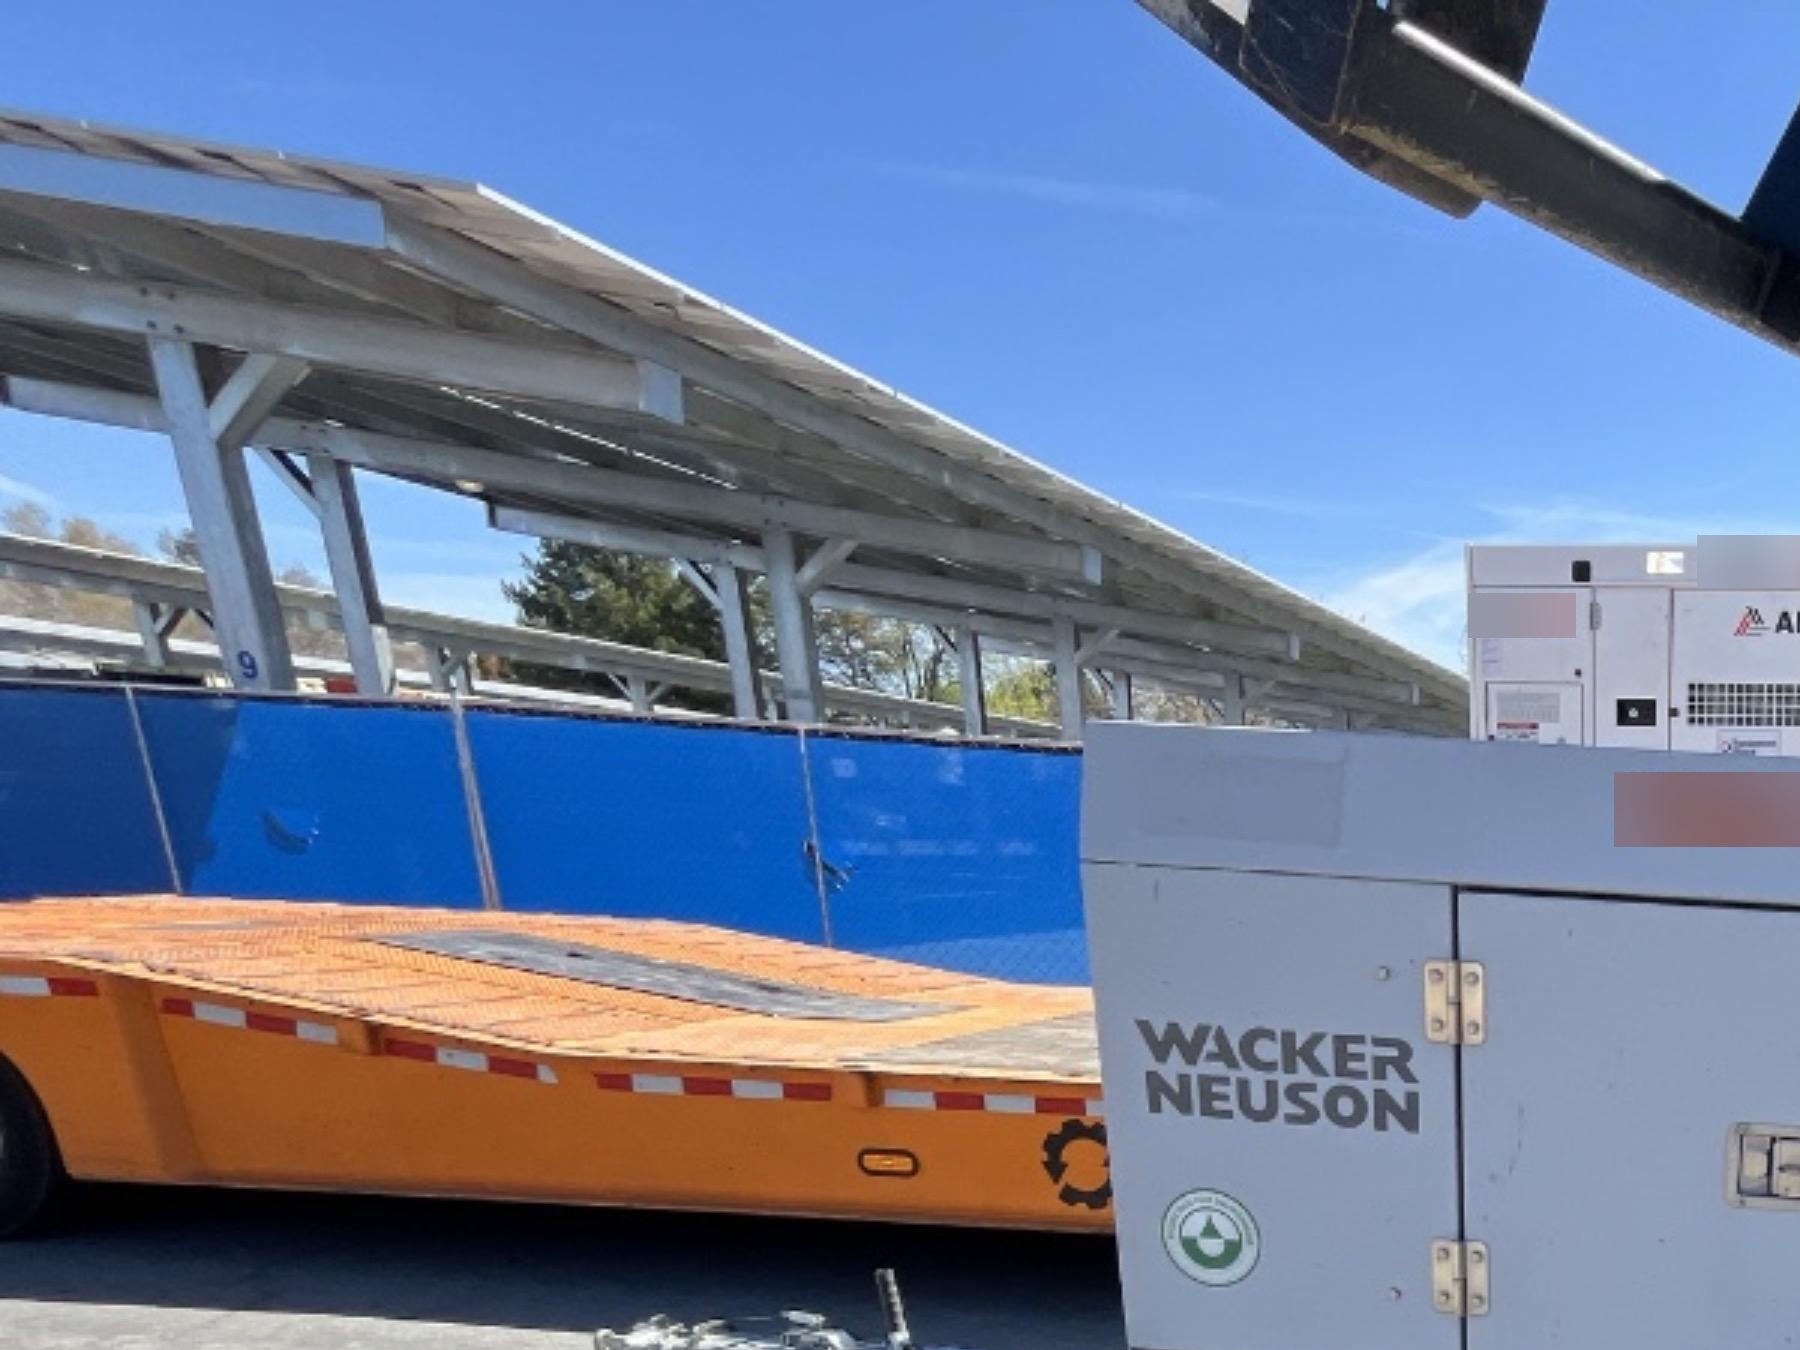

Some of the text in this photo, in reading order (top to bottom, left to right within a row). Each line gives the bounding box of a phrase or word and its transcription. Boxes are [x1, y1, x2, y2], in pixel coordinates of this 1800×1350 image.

[238, 650, 259, 679] 9
[1134, 1019, 1419, 1083] WACKER
[1145, 1070, 1421, 1135] NEUSON
